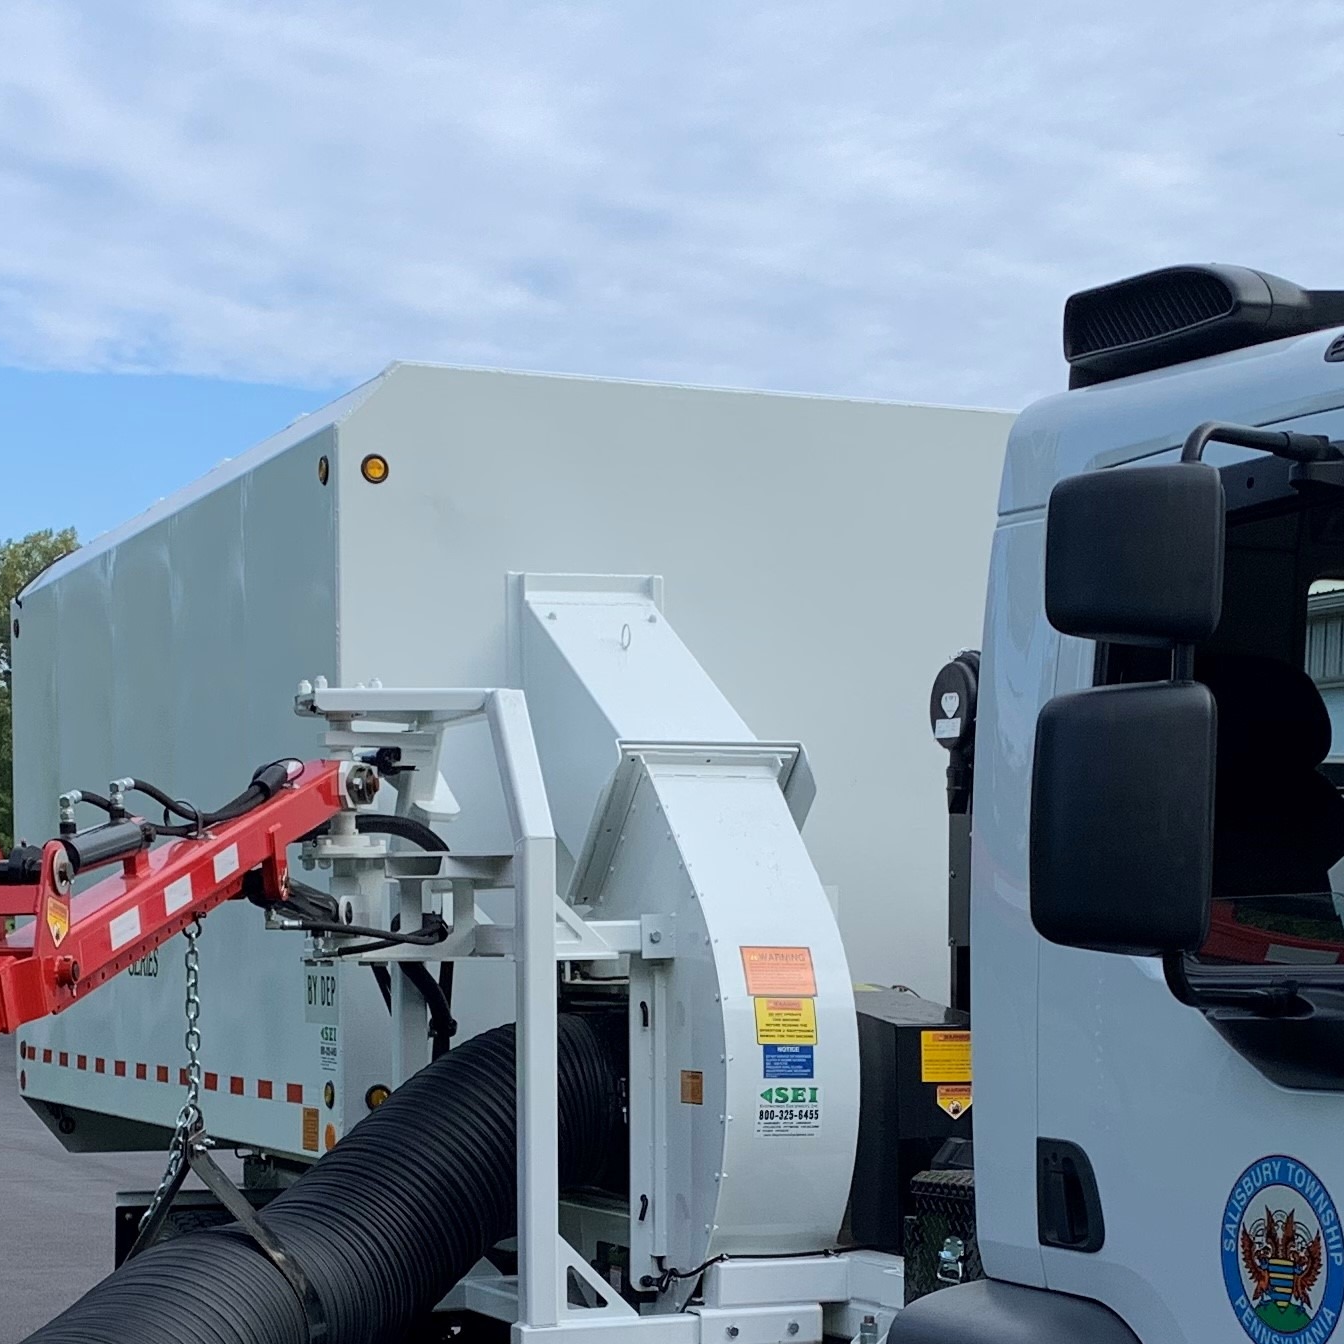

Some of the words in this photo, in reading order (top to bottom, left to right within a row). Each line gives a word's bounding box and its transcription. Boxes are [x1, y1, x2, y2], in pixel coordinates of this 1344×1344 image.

[758, 953, 806, 962] WARNING
[308, 975, 318, 1005] BY
[321, 976, 336, 1006] DEP
[774, 1087, 819, 1104] SEI
[758, 1109, 819, 1121] 800-325-6455
[1224, 1161, 1281, 1252] SALISBURY
[1287, 1162, 1343, 1266] TOWNSHIP
